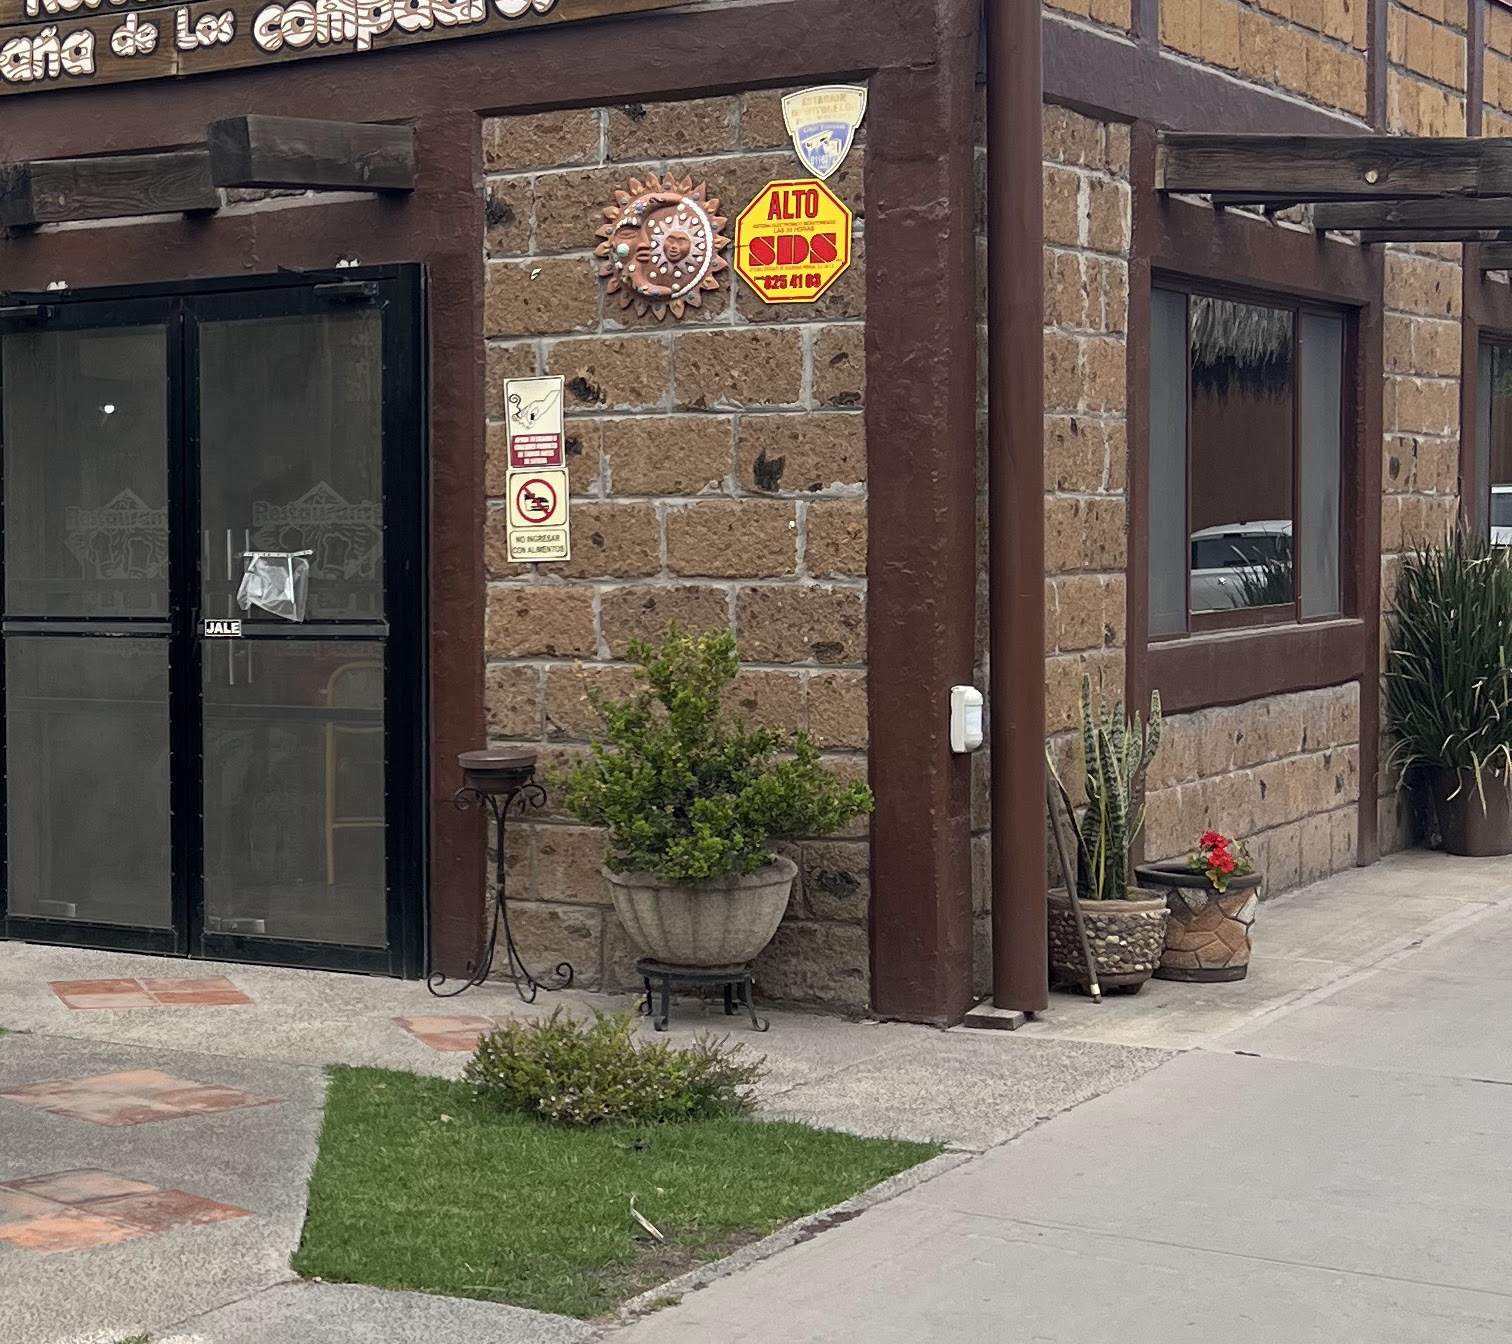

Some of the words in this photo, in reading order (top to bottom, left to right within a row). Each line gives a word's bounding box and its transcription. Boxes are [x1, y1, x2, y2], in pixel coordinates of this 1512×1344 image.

[111, 13, 159, 56] de
[177, 7, 235, 50] Los
[767, 188, 819, 220] ALTO
[749, 233, 838, 266] SDS
[206, 622, 240, 634] JALE
